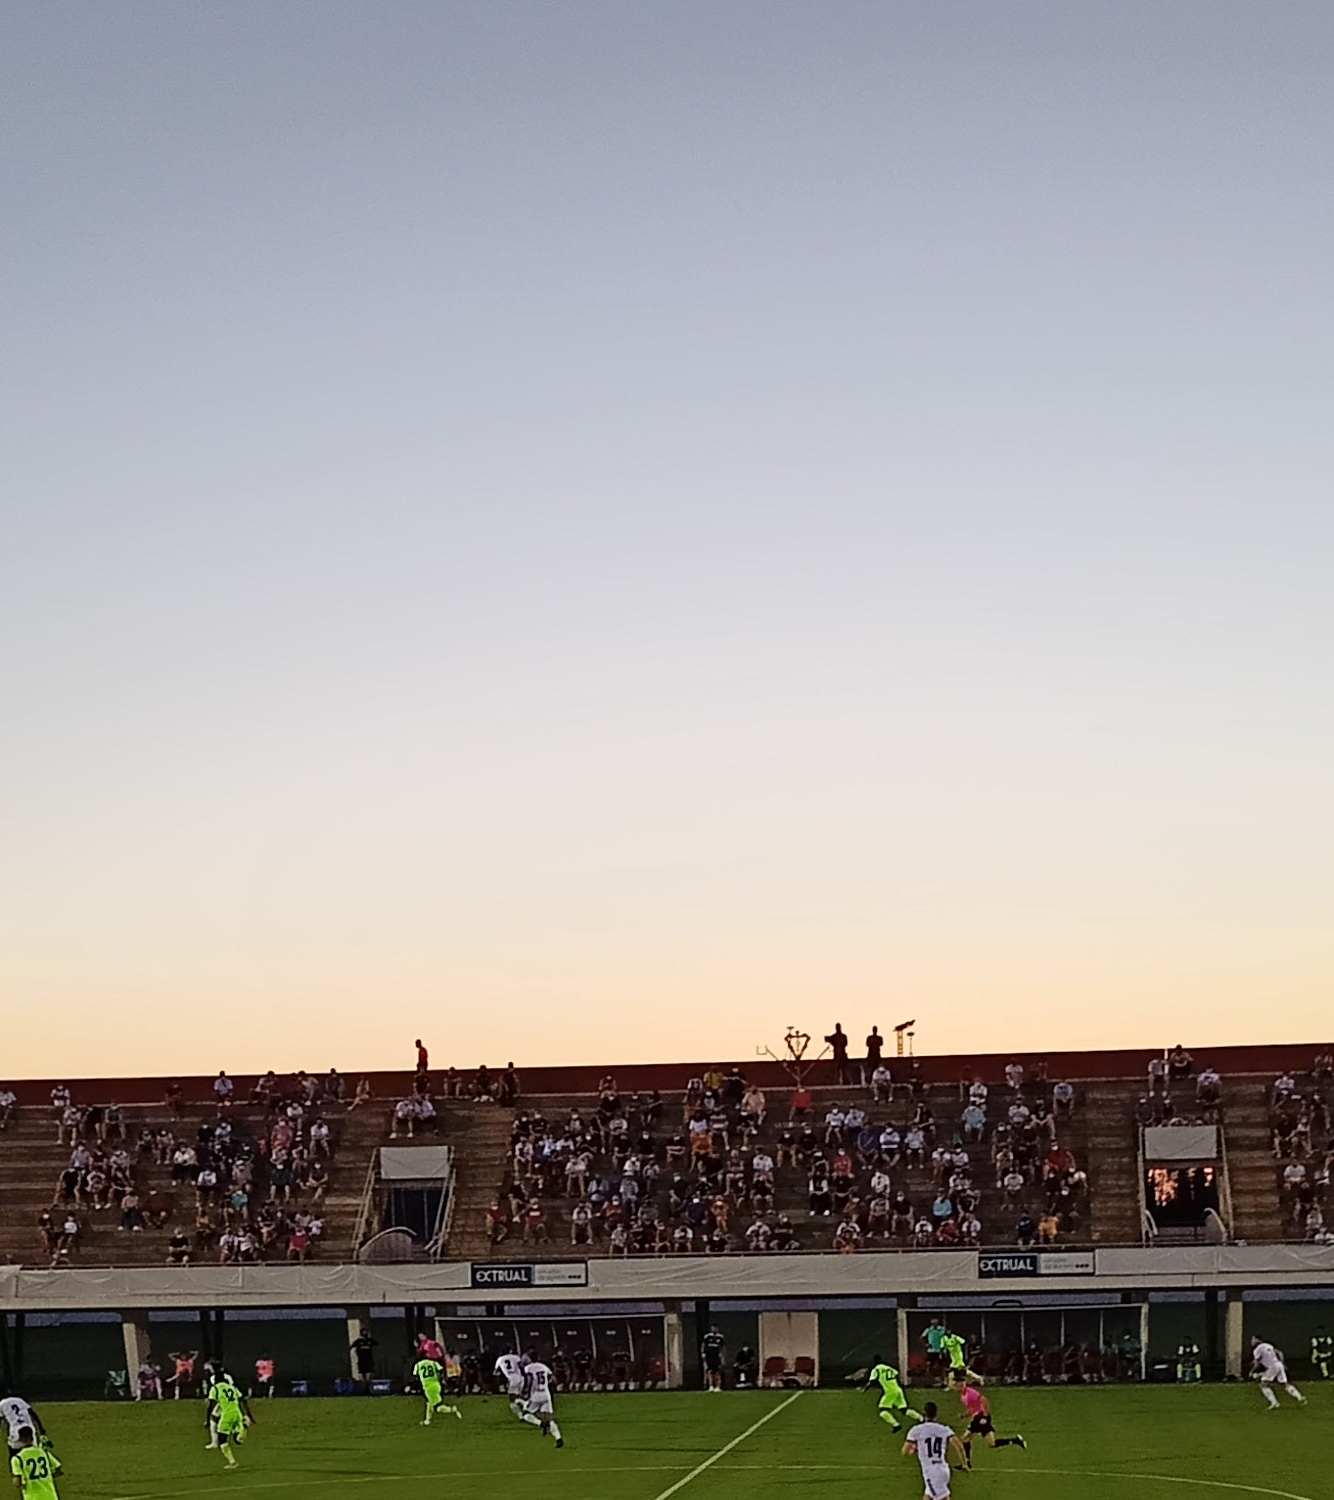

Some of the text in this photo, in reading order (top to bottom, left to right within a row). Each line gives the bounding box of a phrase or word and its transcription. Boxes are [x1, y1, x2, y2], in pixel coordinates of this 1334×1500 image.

[420, 1365, 435, 1379] 28
[924, 1437, 942, 1459] 14
[26, 1457, 48, 1480] 23
